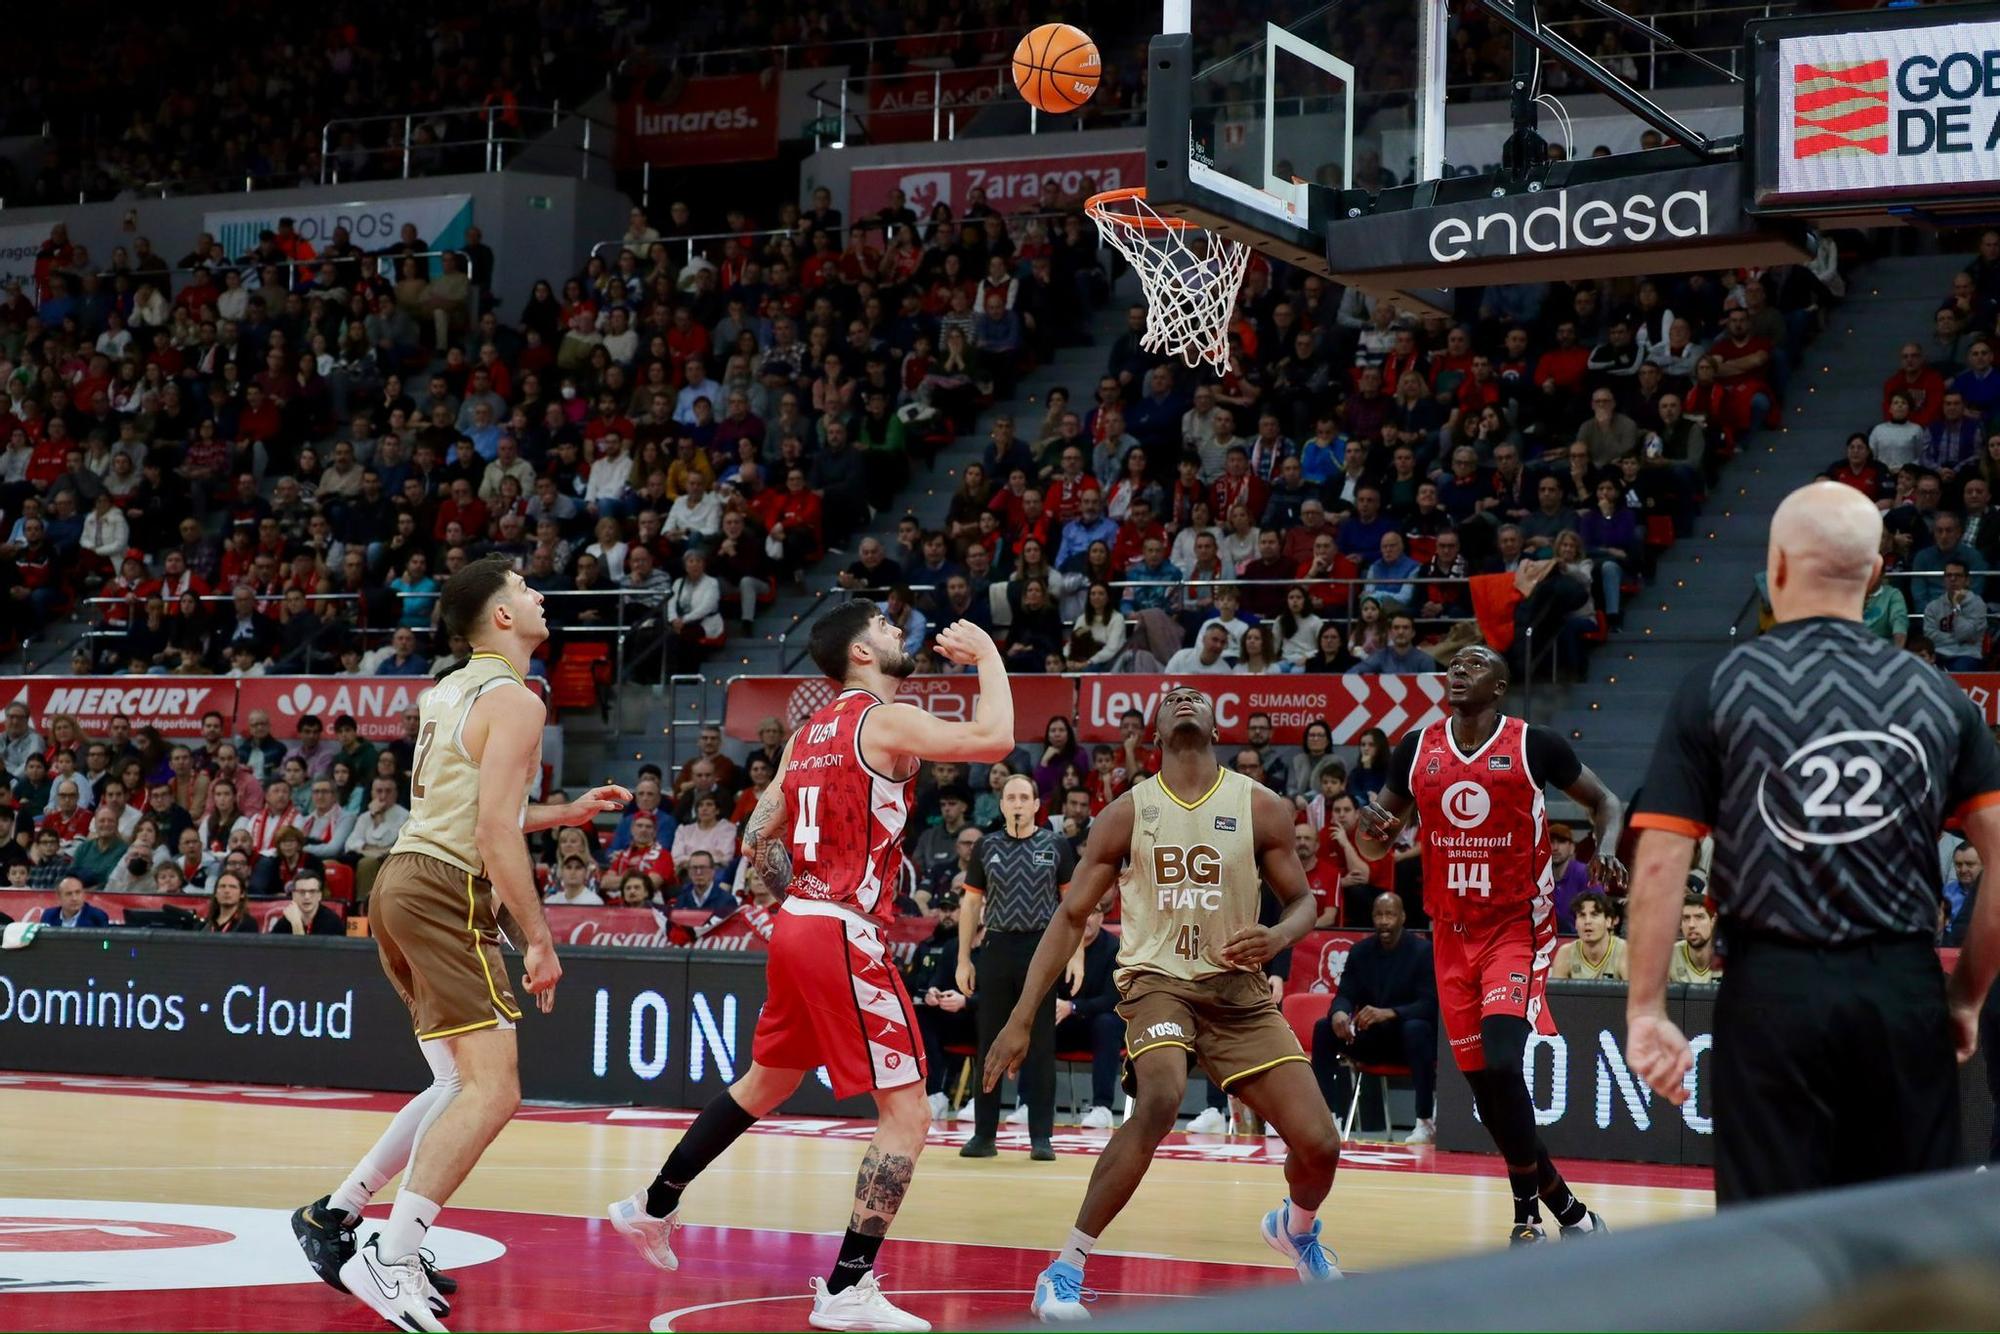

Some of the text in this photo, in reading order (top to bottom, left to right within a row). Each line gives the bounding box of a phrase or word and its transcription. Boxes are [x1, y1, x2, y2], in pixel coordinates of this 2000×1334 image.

[635, 104, 759, 136] lunares.
[1897, 105, 1973, 156] DE
[1428, 189, 1709, 263] endesa
[43, 687, 211, 715] MERCURY
[900, 680, 951, 694] GRUPO
[1248, 693, 1327, 708] SUMAMOS
[152, 717, 202, 732] deportivos
[411, 720, 437, 801] 2
[1800, 755, 1885, 817] 22
[793, 785, 820, 862] 4
[1152, 843, 1223, 887] BG
[1447, 862, 1493, 897] 44
[1157, 887, 1223, 912] FIATC
[222, 984, 353, 1040] Cloud
